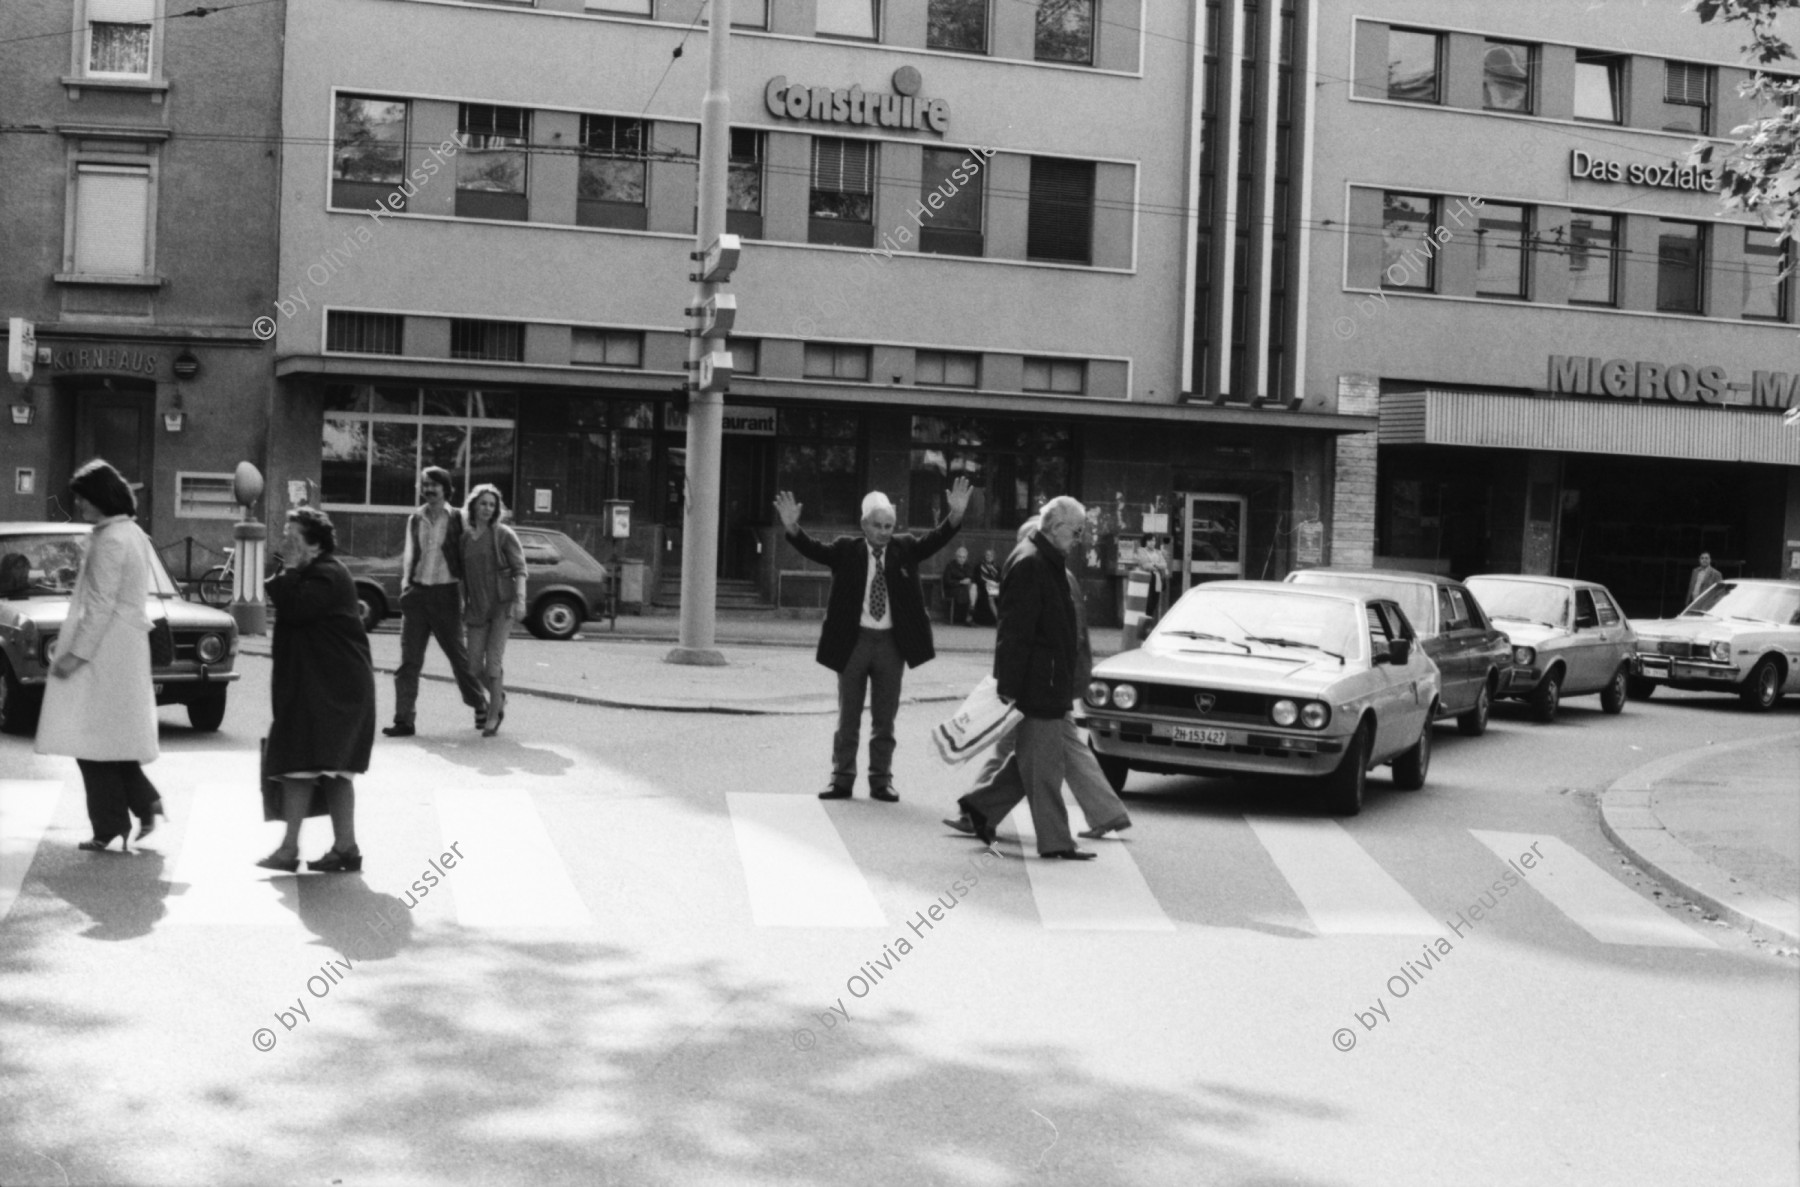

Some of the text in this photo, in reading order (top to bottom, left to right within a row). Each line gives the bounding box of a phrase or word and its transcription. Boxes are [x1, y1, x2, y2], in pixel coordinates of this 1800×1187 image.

[764, 65, 951, 133] Construire
[1571, 149, 1622, 181] Das
[53, 348, 157, 374] KORNHAUS
